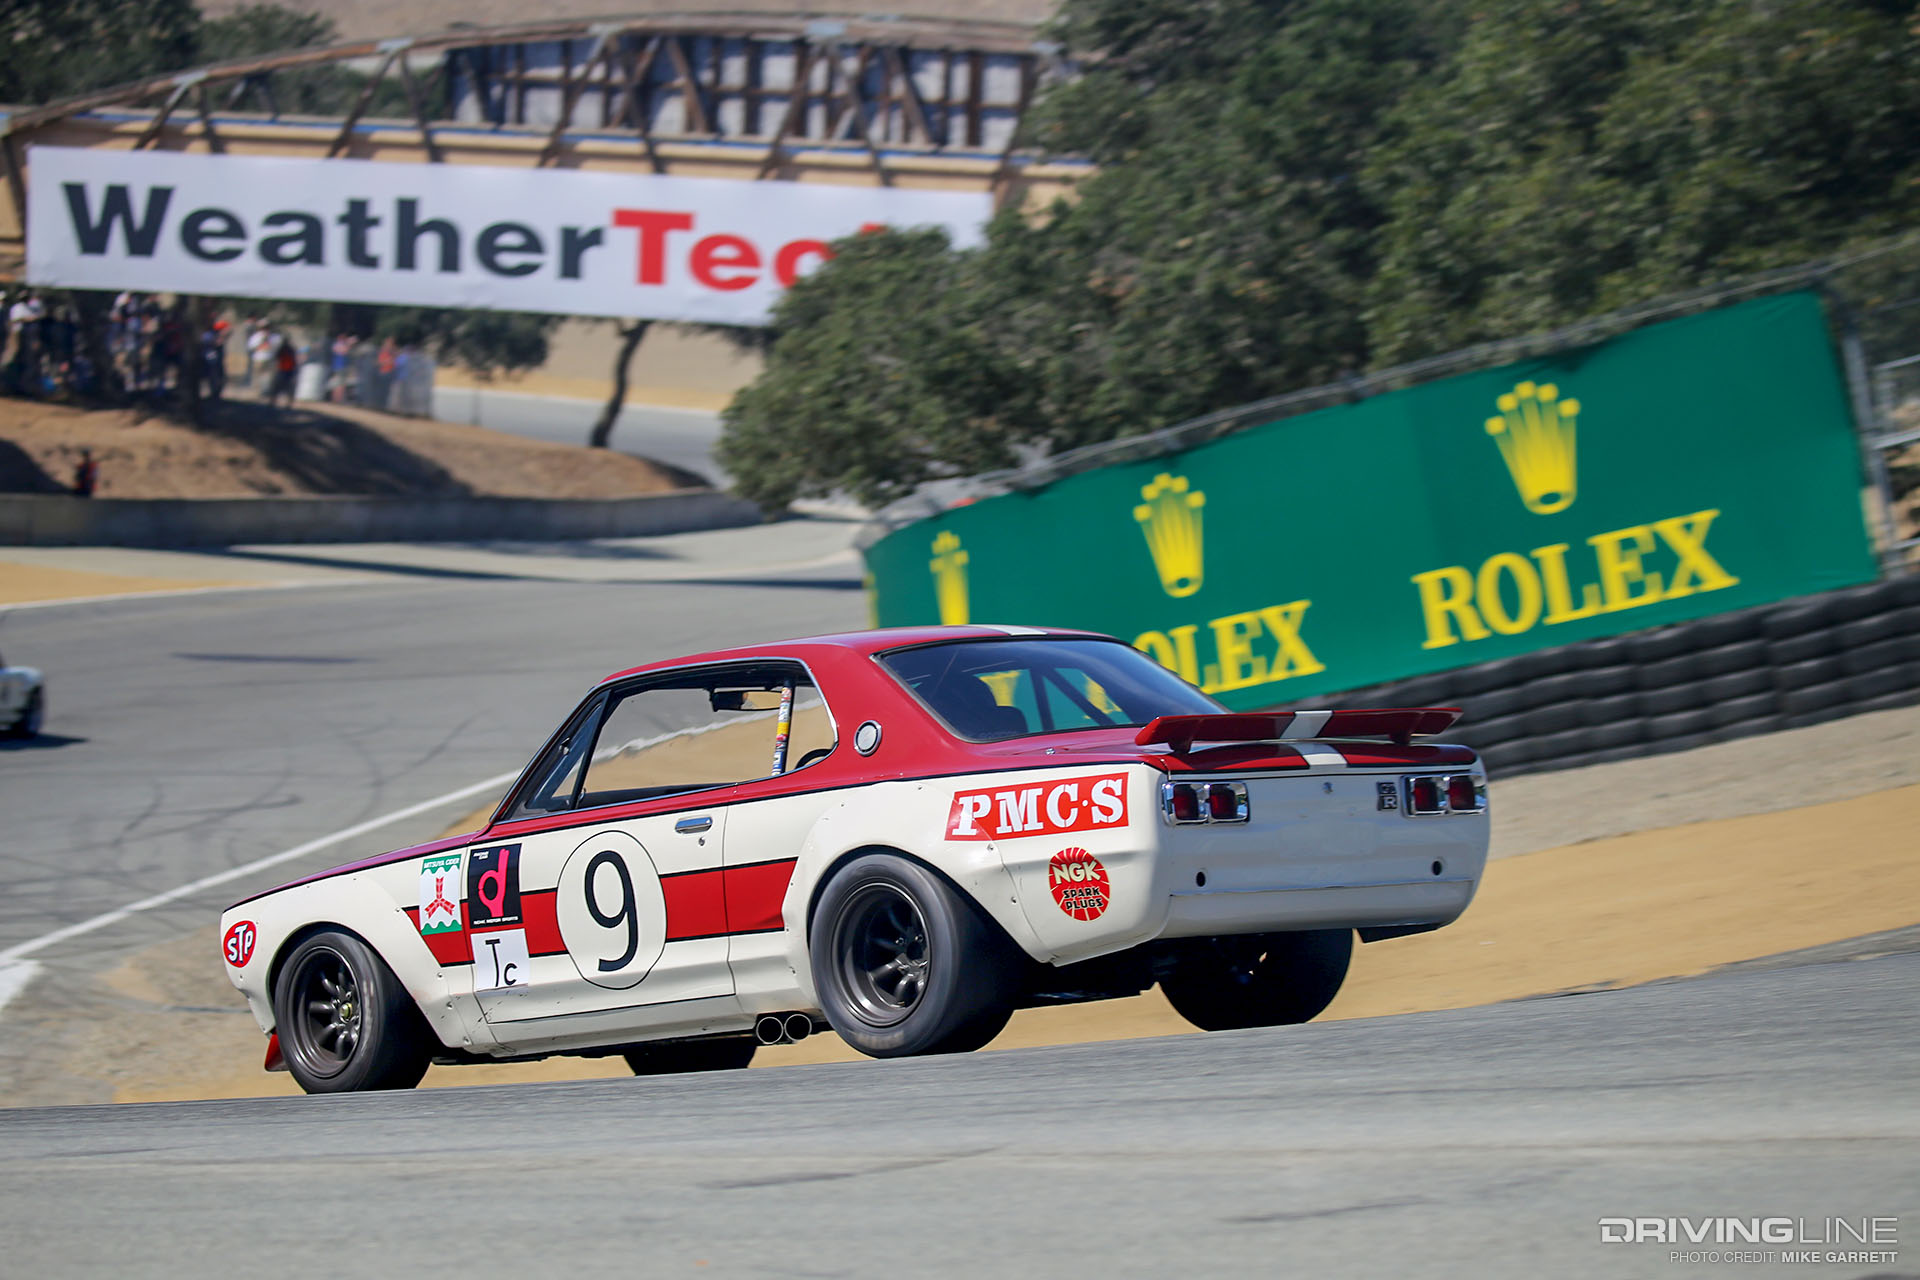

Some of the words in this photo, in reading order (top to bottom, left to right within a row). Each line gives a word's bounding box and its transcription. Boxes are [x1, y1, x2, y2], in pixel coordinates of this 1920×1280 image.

[63, 182, 889, 292] WeatherTec
[1411, 508, 1740, 650] ROLEX
[1131, 599, 1326, 695] OLEX
[1051, 860, 1102, 885] NGK
[1062, 887, 1101, 899] SPARK
[1065, 898, 1104, 910] PLUGS
[226, 923, 254, 963] STP
[584, 850, 638, 972] 9
